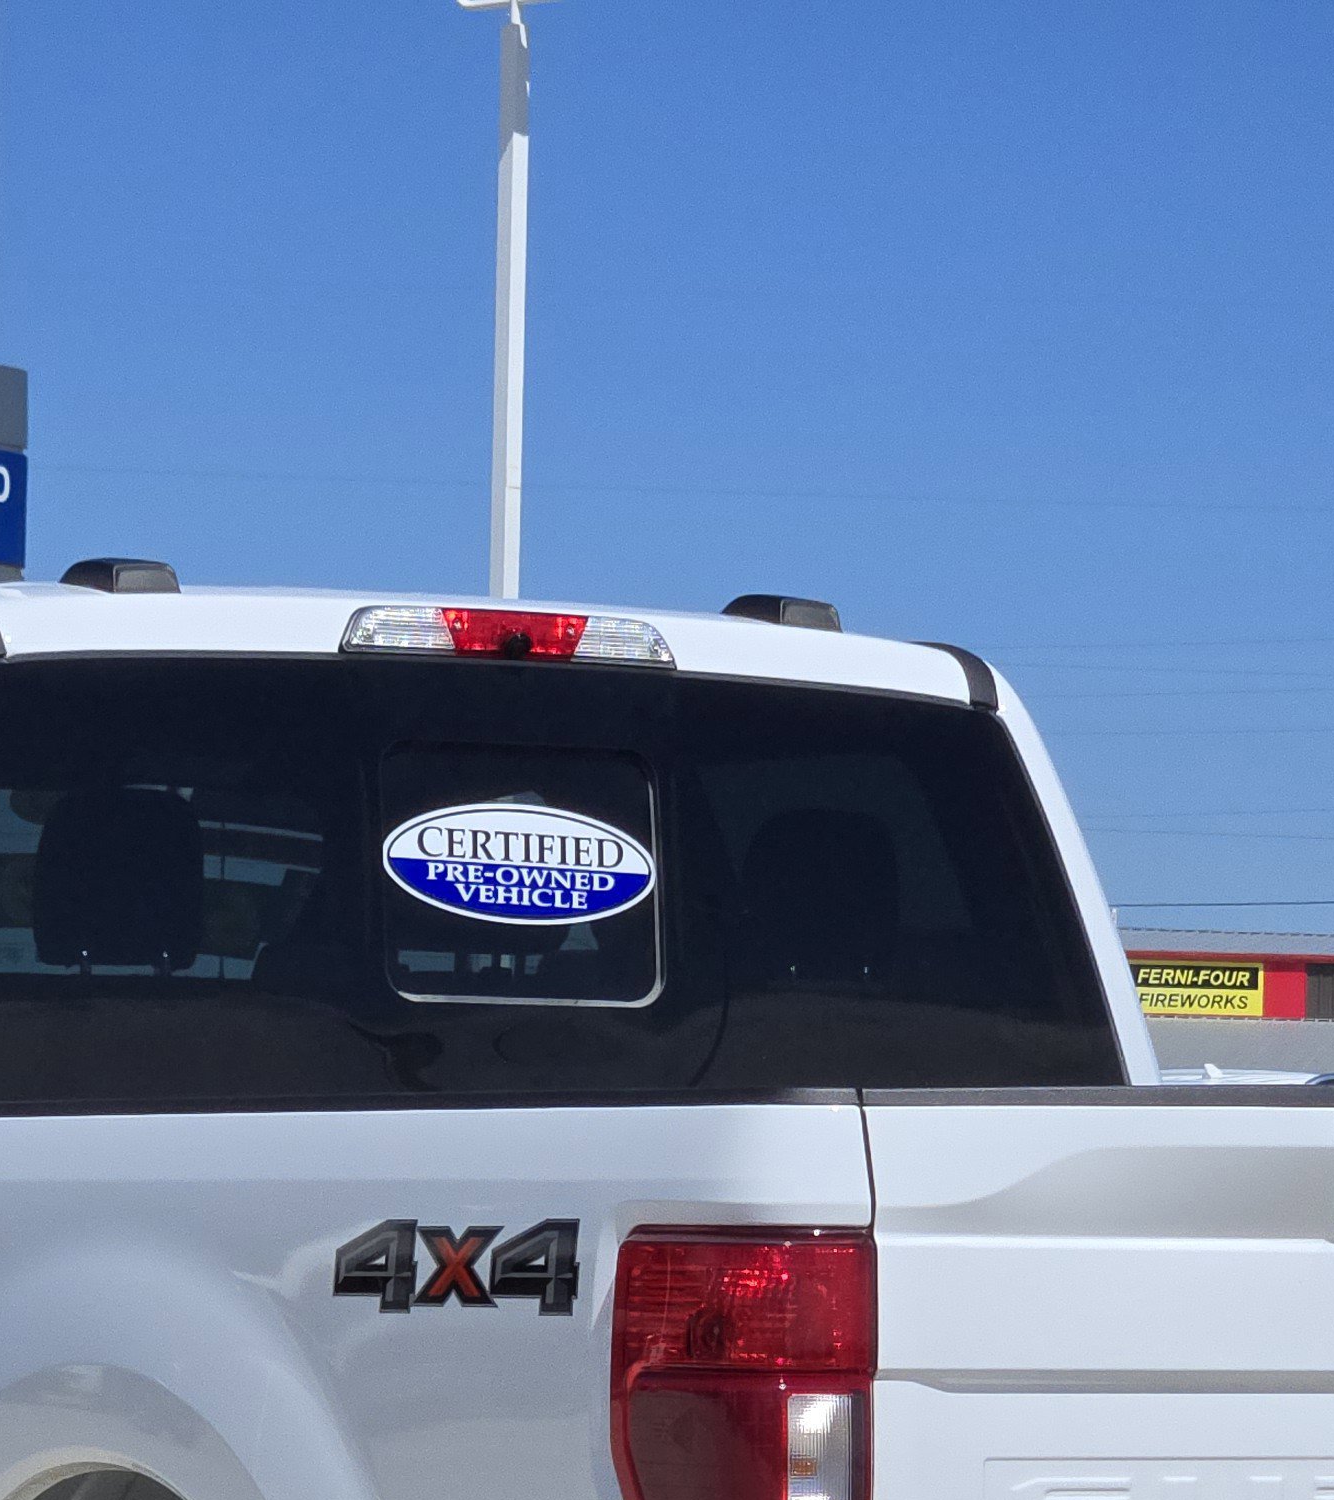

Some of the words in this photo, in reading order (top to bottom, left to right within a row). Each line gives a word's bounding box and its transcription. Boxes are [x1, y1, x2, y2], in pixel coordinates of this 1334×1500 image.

[417, 826, 624, 869] CERTIFIED
[426, 861, 615, 892] PRE-OWNED
[455, 883, 588, 910] VEHICLE
[1137, 968, 1251, 987] FERNI-FOUR
[1139, 992, 1249, 1011] FIREWORKS
